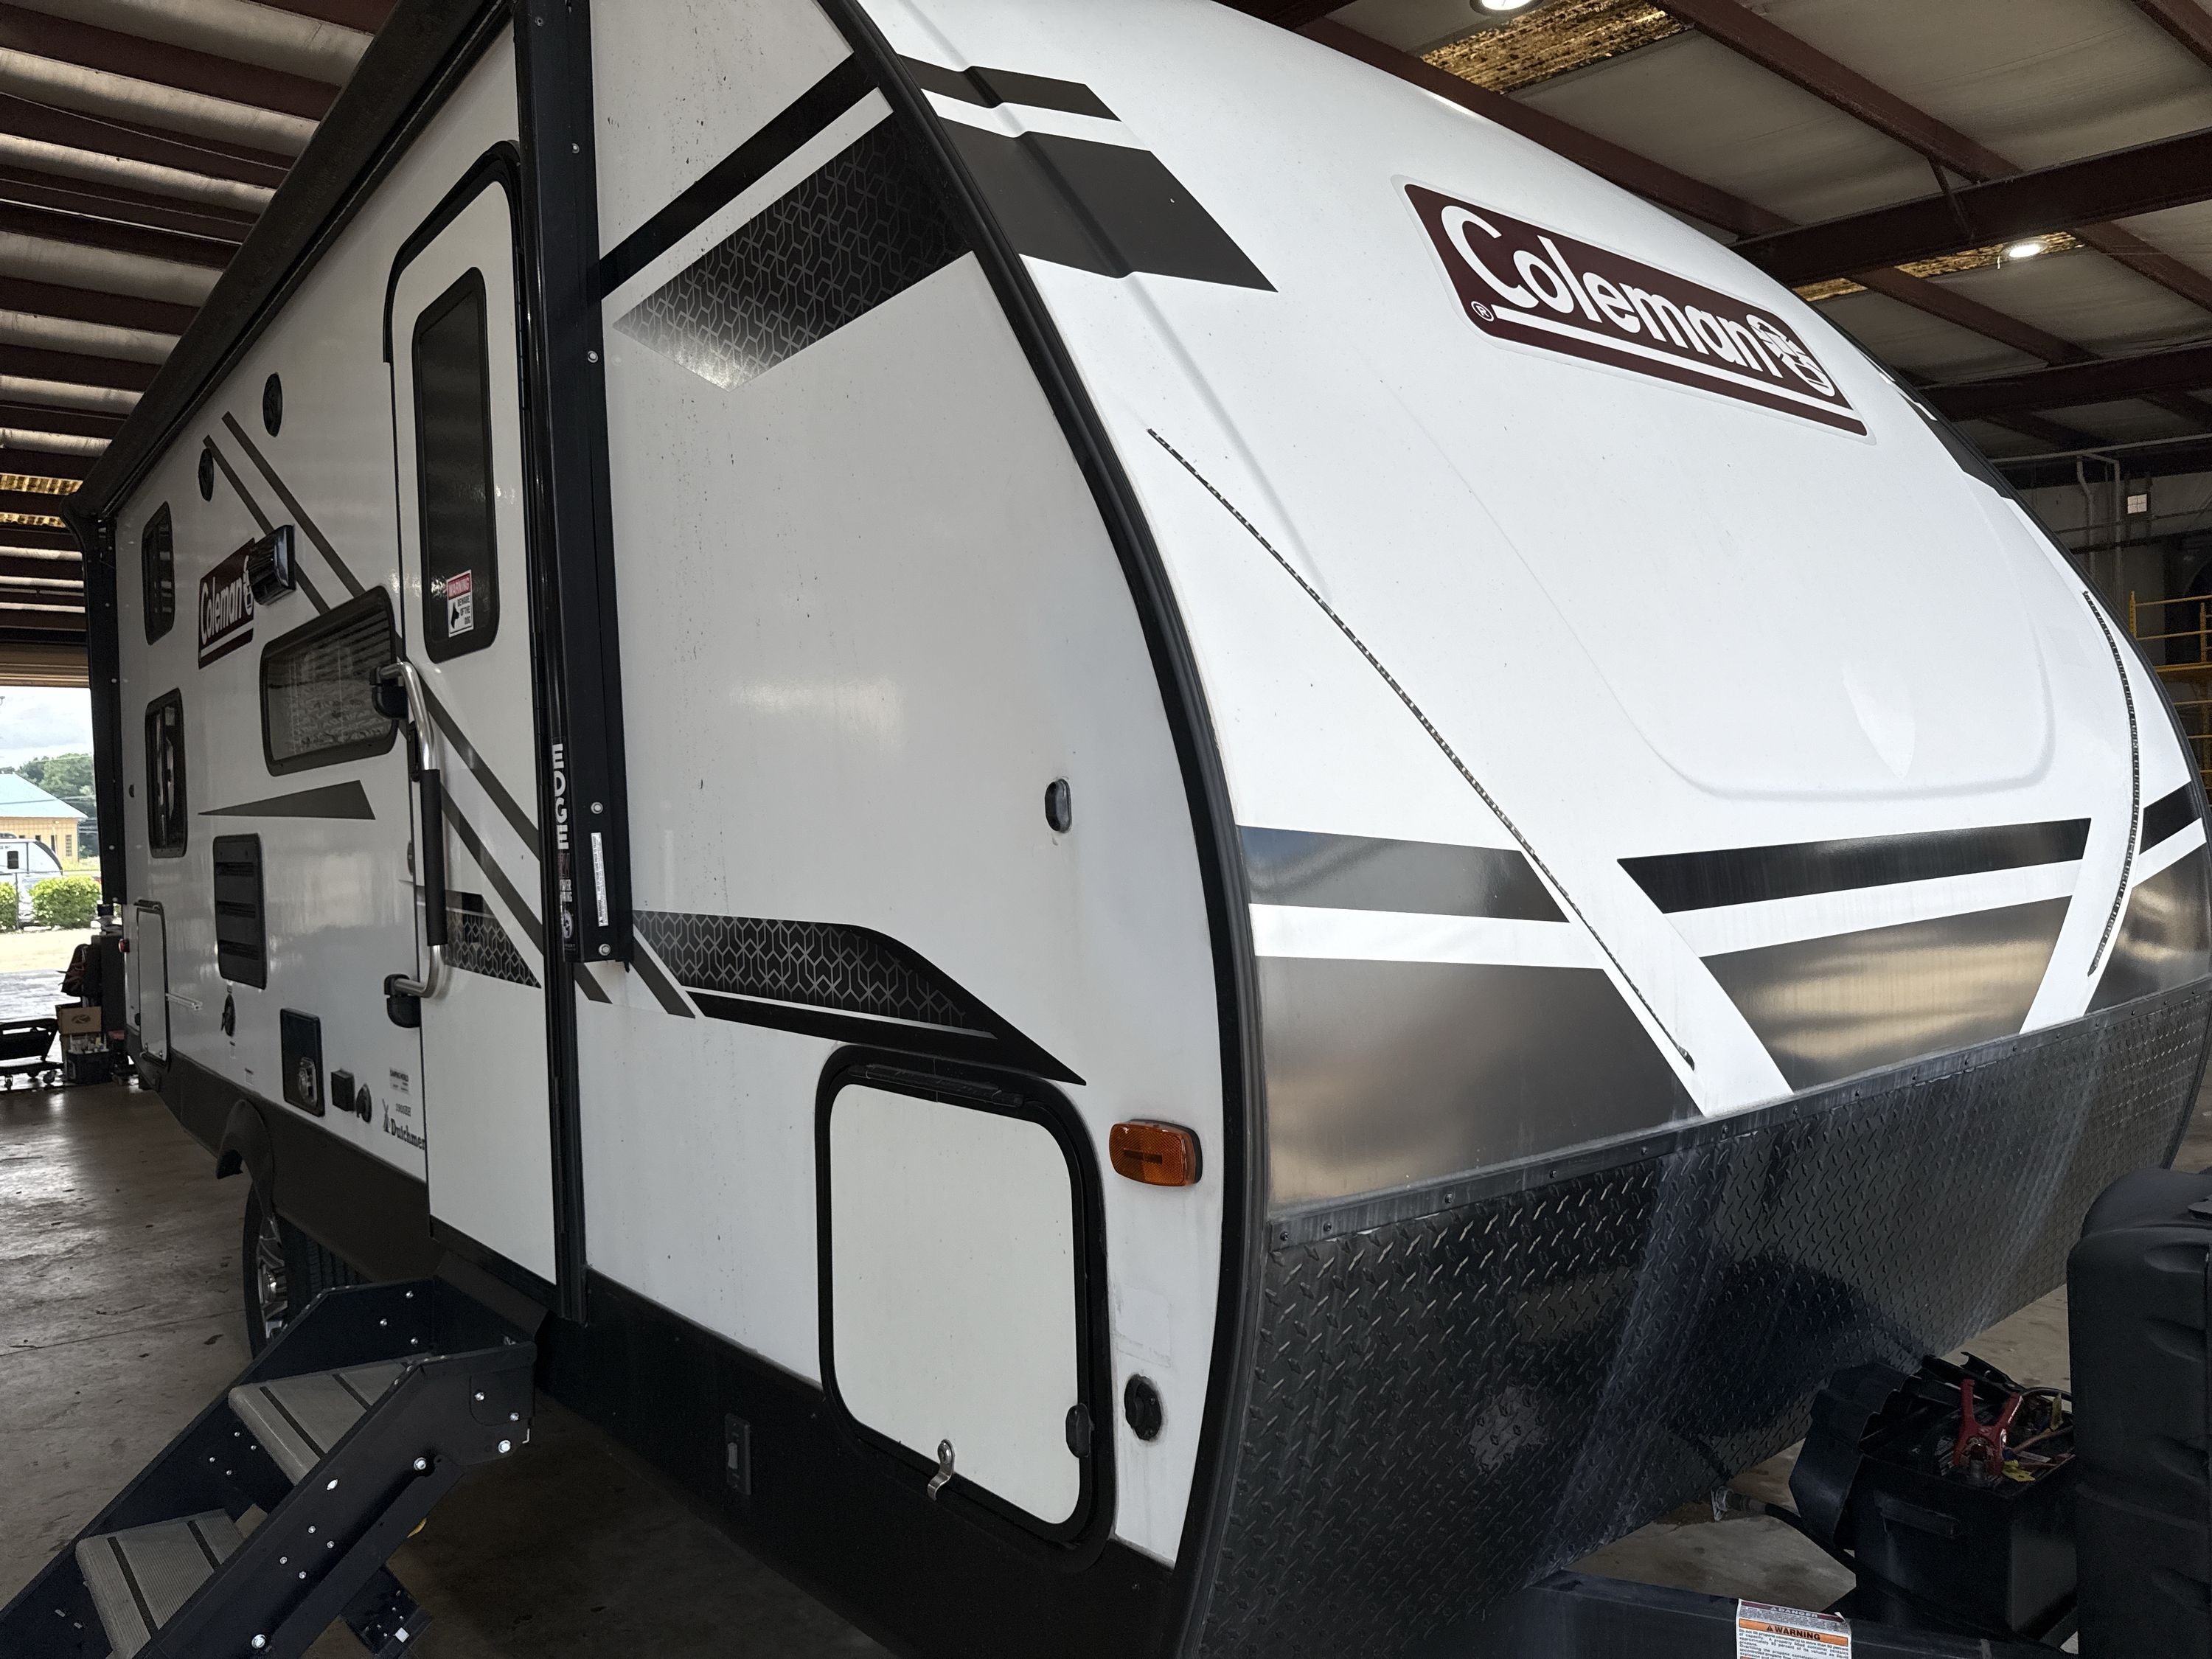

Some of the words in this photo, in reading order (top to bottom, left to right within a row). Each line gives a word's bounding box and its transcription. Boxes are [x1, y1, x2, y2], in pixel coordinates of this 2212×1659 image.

[1441, 206, 1784, 379] Coleman
[201, 576, 243, 645] Coleman
[552, 743, 569, 849] EDGE
[1775, 1626, 1820, 1640] WARNING
[1778, 1608, 1818, 1618] DANGER
